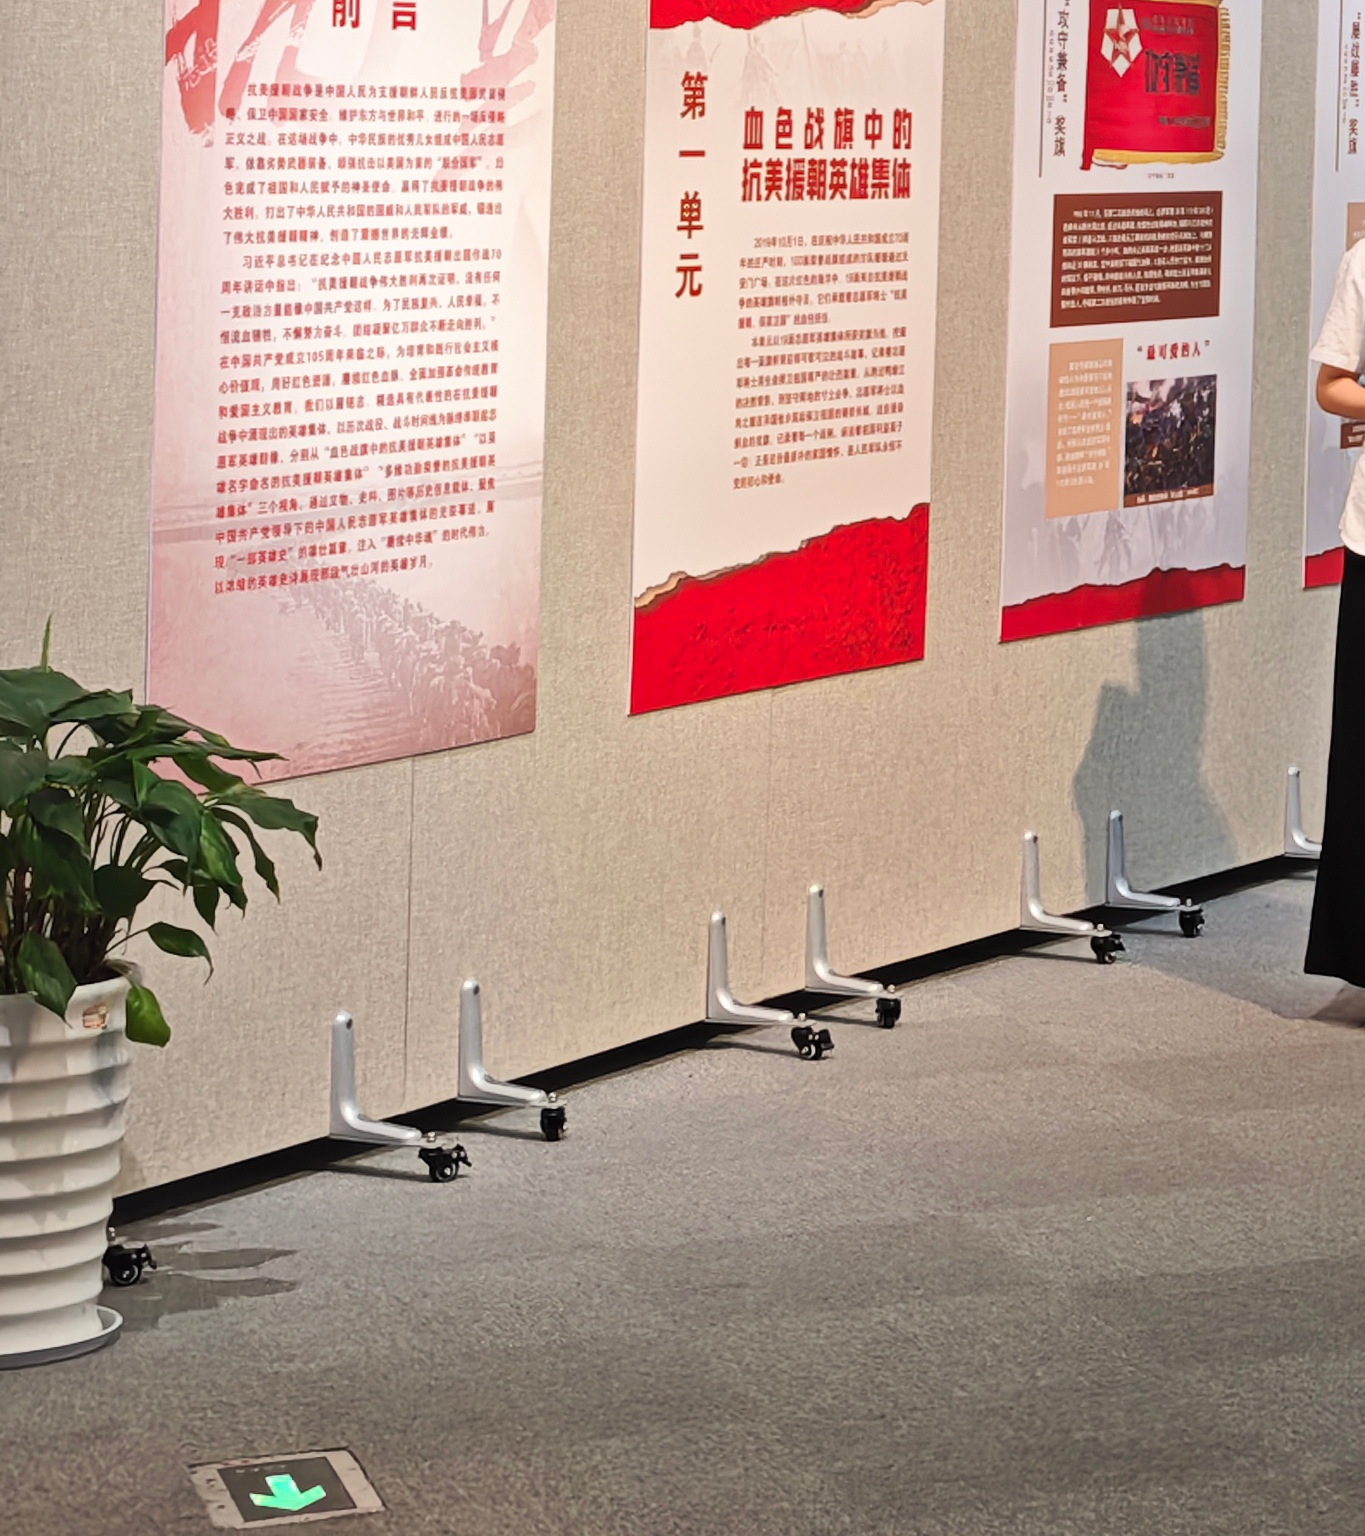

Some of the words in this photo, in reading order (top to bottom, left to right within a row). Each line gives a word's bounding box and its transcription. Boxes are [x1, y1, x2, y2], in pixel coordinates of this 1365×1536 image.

[742, 106, 913, 151] 血色战旗中的
[1053, 114, 1067, 158] 奖旗
[673, 70, 709, 299] 第一单元
[740, 157, 912, 203] 抗美援朝英雄集体
